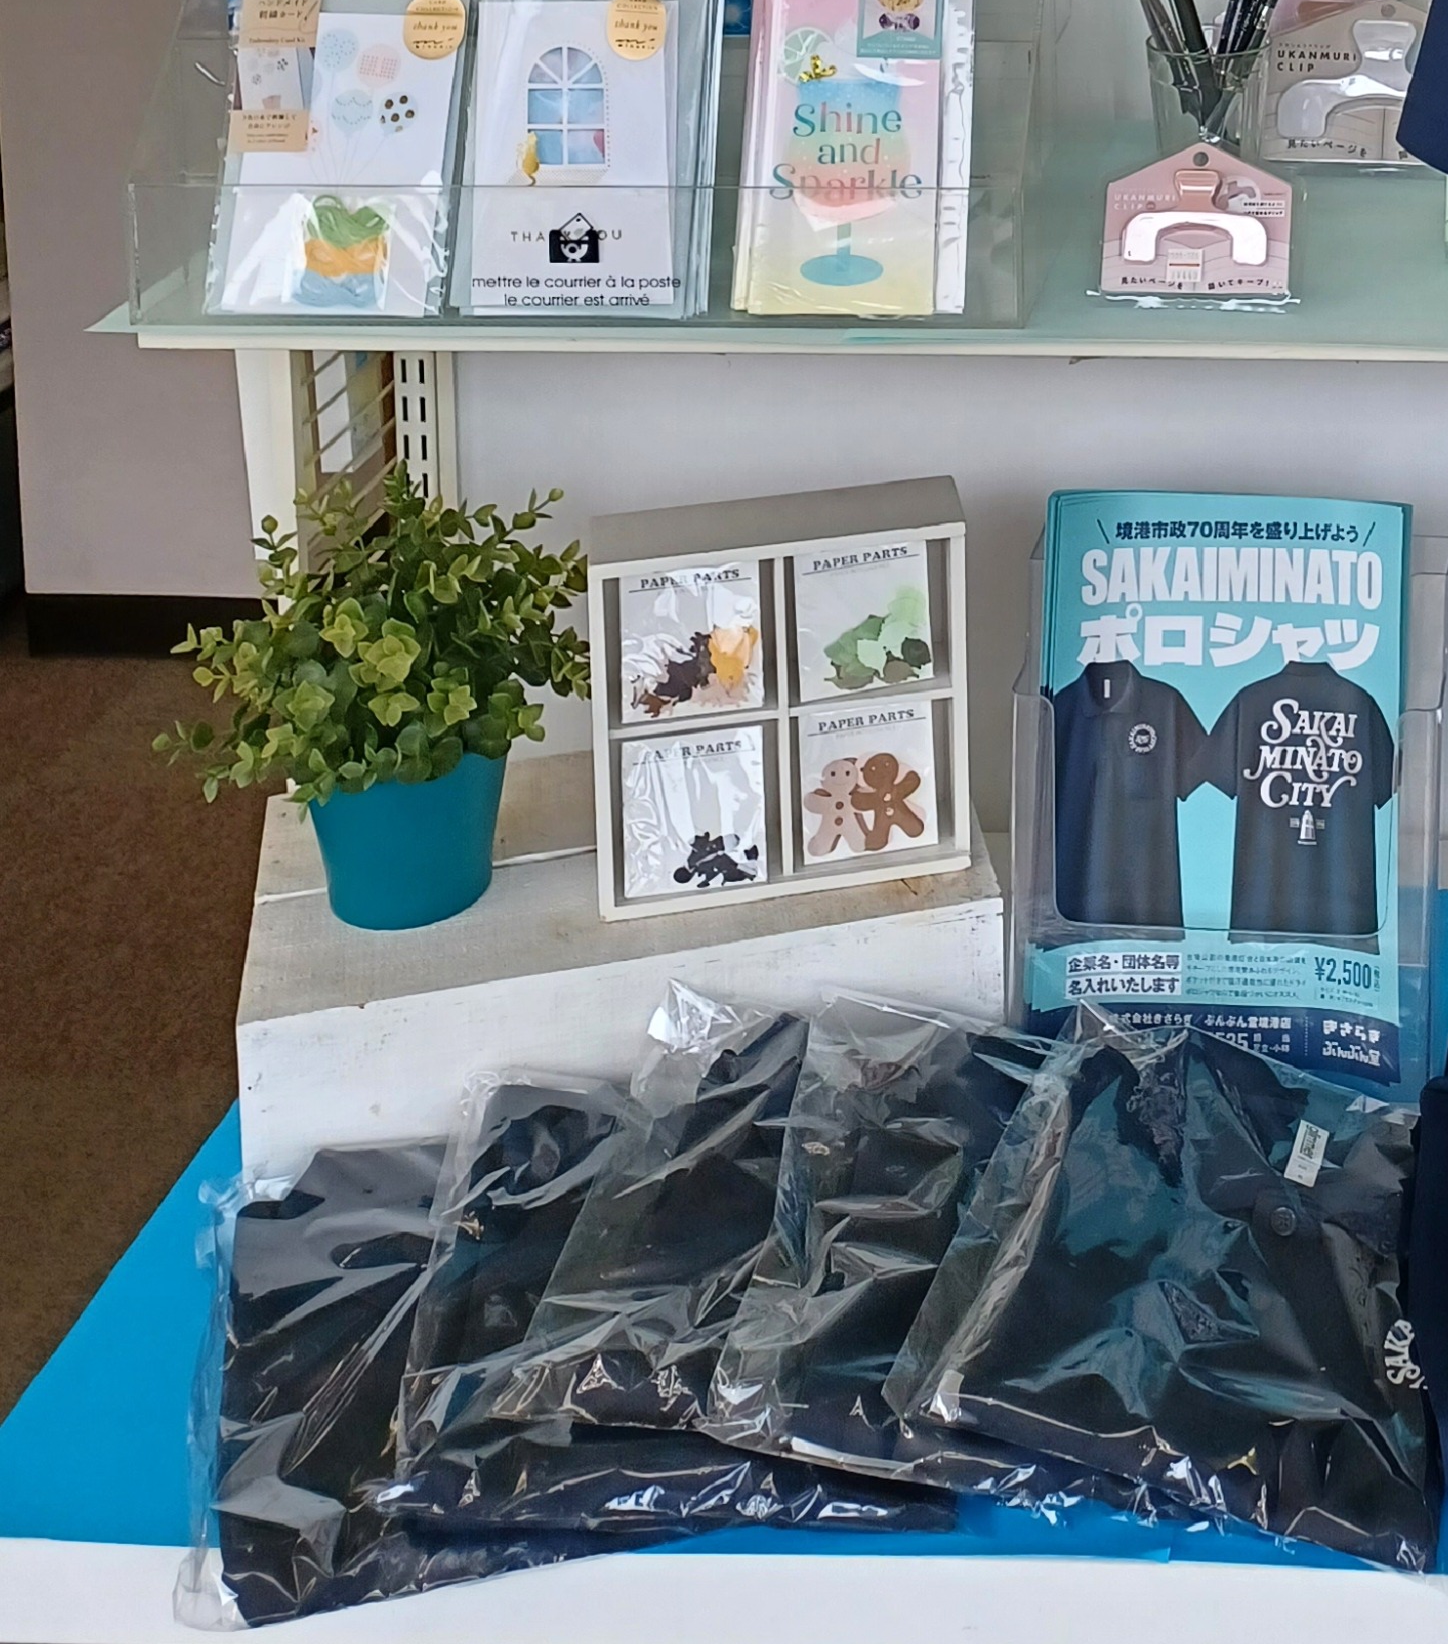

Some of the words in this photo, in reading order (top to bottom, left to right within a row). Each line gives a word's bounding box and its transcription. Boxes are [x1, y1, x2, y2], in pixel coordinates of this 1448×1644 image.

[1277, 50, 1356, 62] UKANMURI
[1277, 62, 1315, 72] CLIP
[793, 102, 902, 137] Shine
[817, 138, 881, 166] and
[769, 164, 923, 202] Sparkle
[598, 230, 622, 240] OU
[472, 276, 522, 288] mettre
[526, 276, 540, 288] le
[544, 276, 600, 288] courrier
[605, 275, 616, 288] à
[621, 276, 635, 288] la
[639, 276, 681, 290] poste
[504, 293, 517, 306] le
[521, 293, 580, 306] courrier
[584, 294, 604, 306] est
[608, 293, 650, 306] arrivé
[1115, 520, 1359, 543] 境港市政70周年を盛り上げよう
[813, 554, 859, 571] PAPER
[863, 546, 908, 563] PARTS
[1081, 546, 1383, 610] SAKAIMINATO
[1077, 603, 1380, 671] ポロシャツ
[818, 716, 865, 732] PAPER
[868, 708, 915, 727] PARTS
[1260, 698, 1358, 747] SAKAI
[695, 740, 742, 755] PARTS
[1243, 736, 1363, 782] MINATO
[1260, 771, 1357, 808] CITY
[1068, 954, 1180, 973] 企業名・団体名等
[1315, 957, 1372, 989] ¥2,500
[1068, 977, 1180, 996] 名入れいたします
